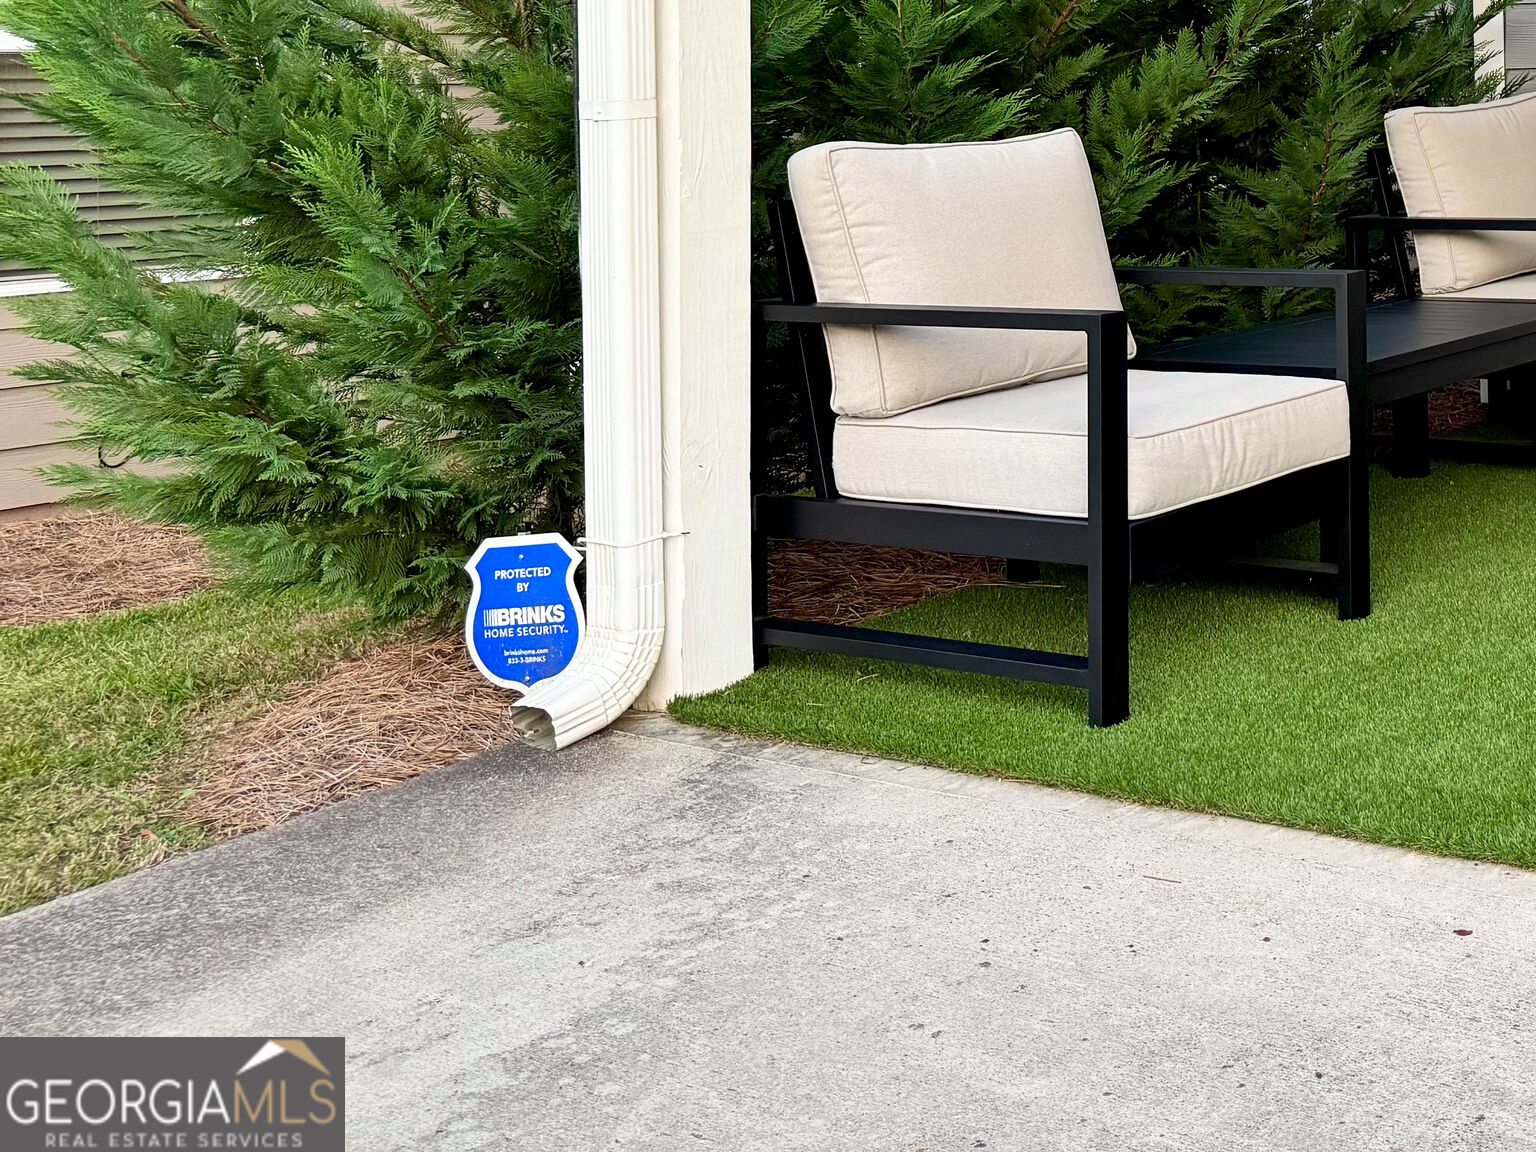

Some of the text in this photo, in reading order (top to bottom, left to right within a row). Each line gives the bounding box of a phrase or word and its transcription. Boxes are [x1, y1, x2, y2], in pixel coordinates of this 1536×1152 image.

[494, 567, 552, 580] PROTECTED
[517, 582, 529, 593] BY
[497, 604, 566, 626] BRINKS
[484, 624, 566, 639] HOME SECURITY
